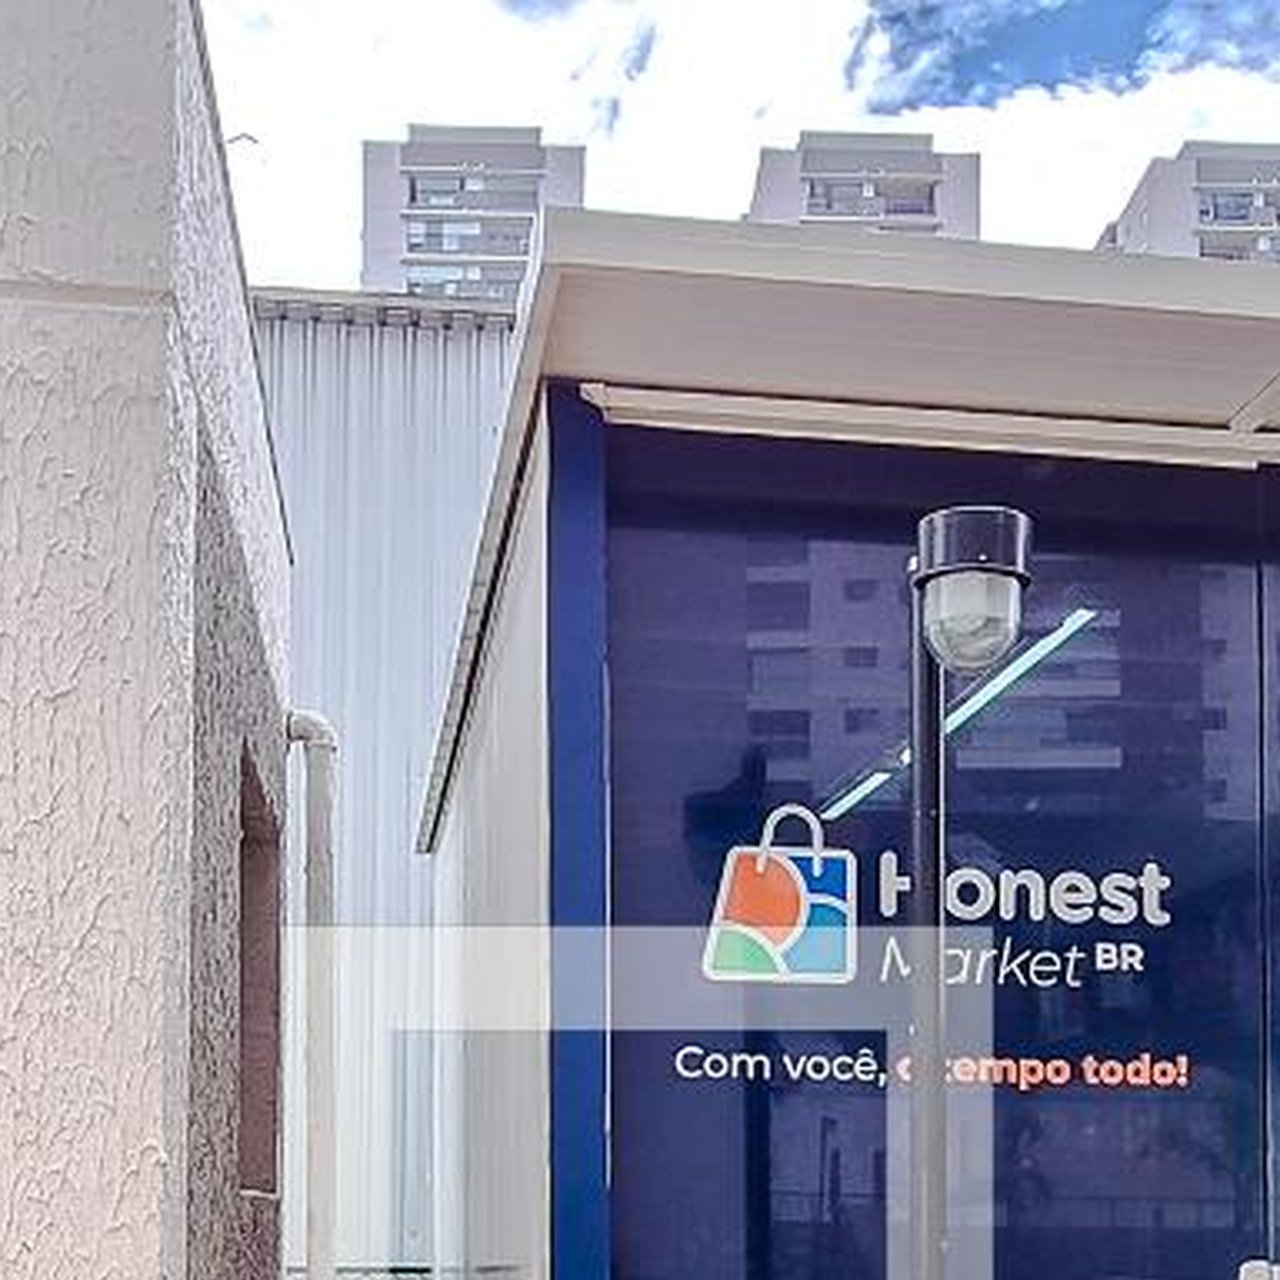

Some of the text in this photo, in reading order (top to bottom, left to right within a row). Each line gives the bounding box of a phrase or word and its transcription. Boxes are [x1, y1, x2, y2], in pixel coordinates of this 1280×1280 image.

[1094, 942, 1144, 971] BR
[675, 1045, 771, 1081] Com
[782, 1047, 888, 1088] você,
[944, 1056, 1071, 1091] empo
[1080, 1053, 1189, 1086] todo!
